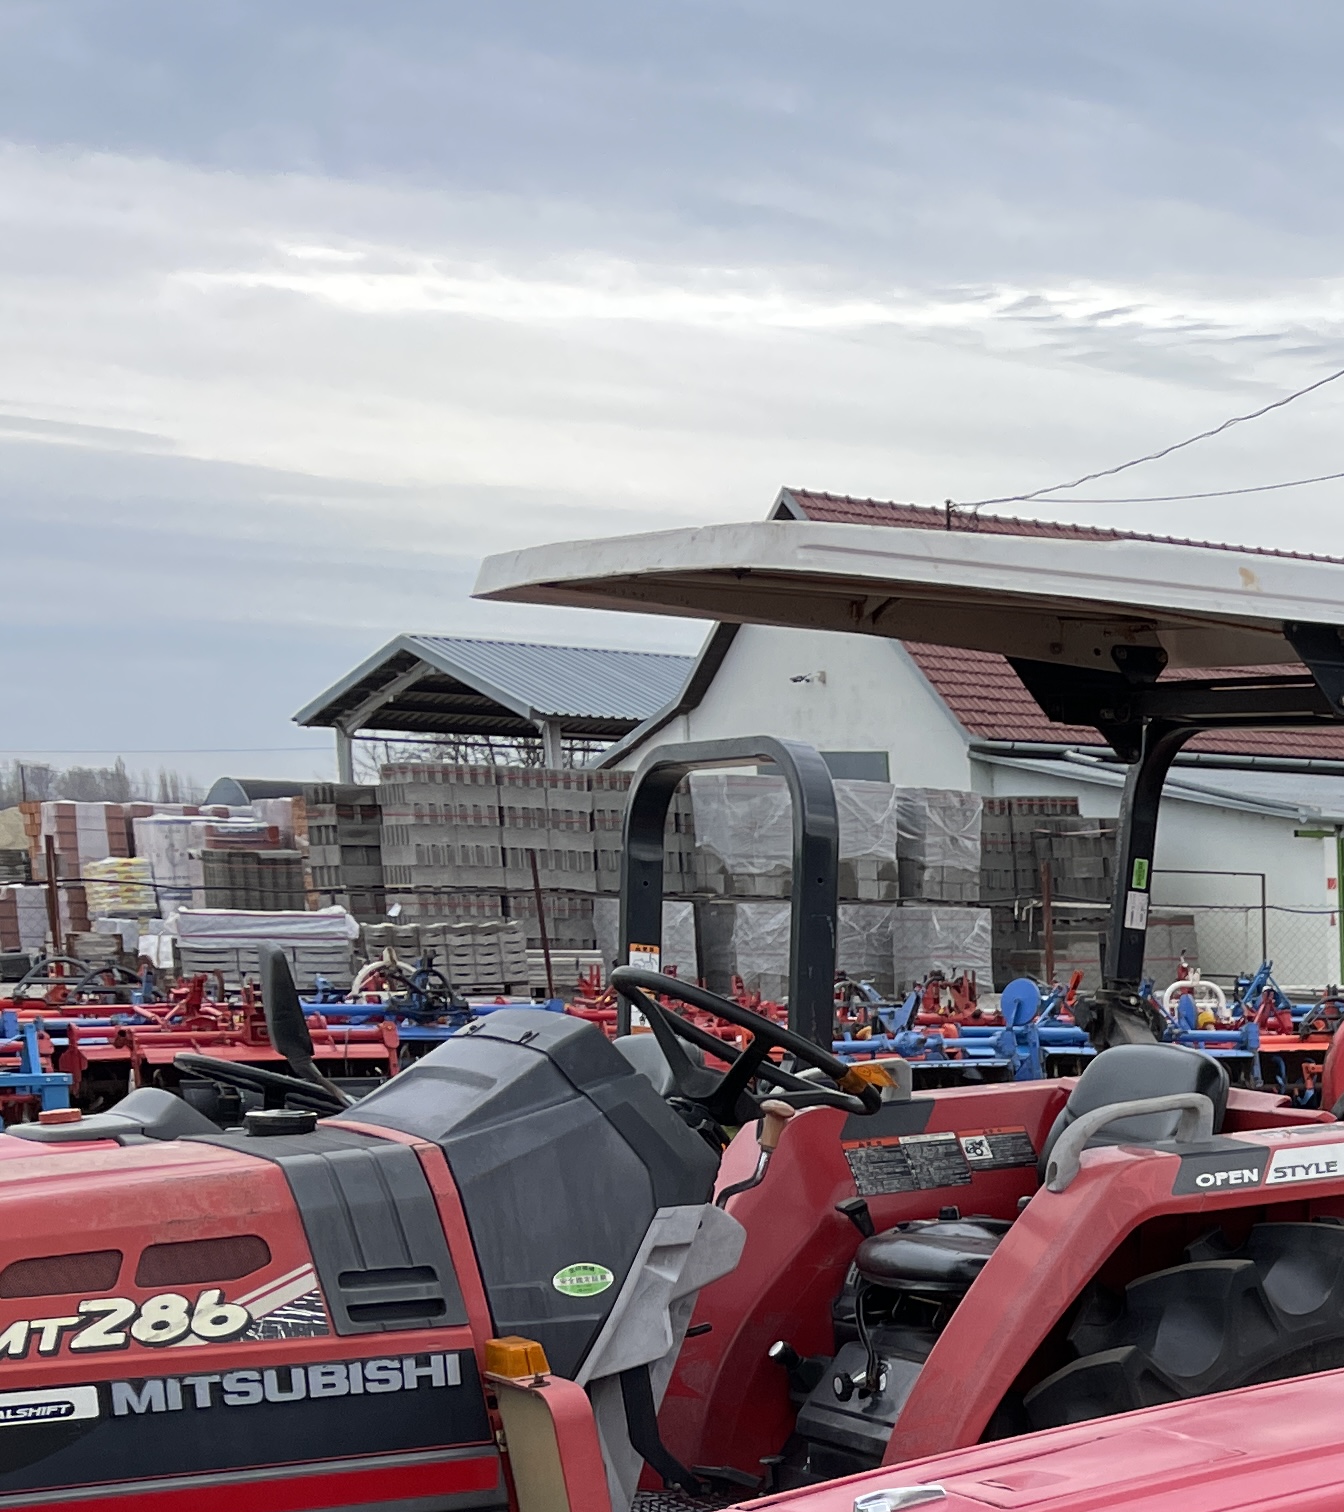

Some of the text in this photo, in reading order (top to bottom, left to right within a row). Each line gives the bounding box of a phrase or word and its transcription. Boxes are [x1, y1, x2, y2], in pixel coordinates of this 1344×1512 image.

[1196, 1160, 1338, 1188] OPEN STYLE
[111, 1352, 462, 1416] MITSUBISHI
